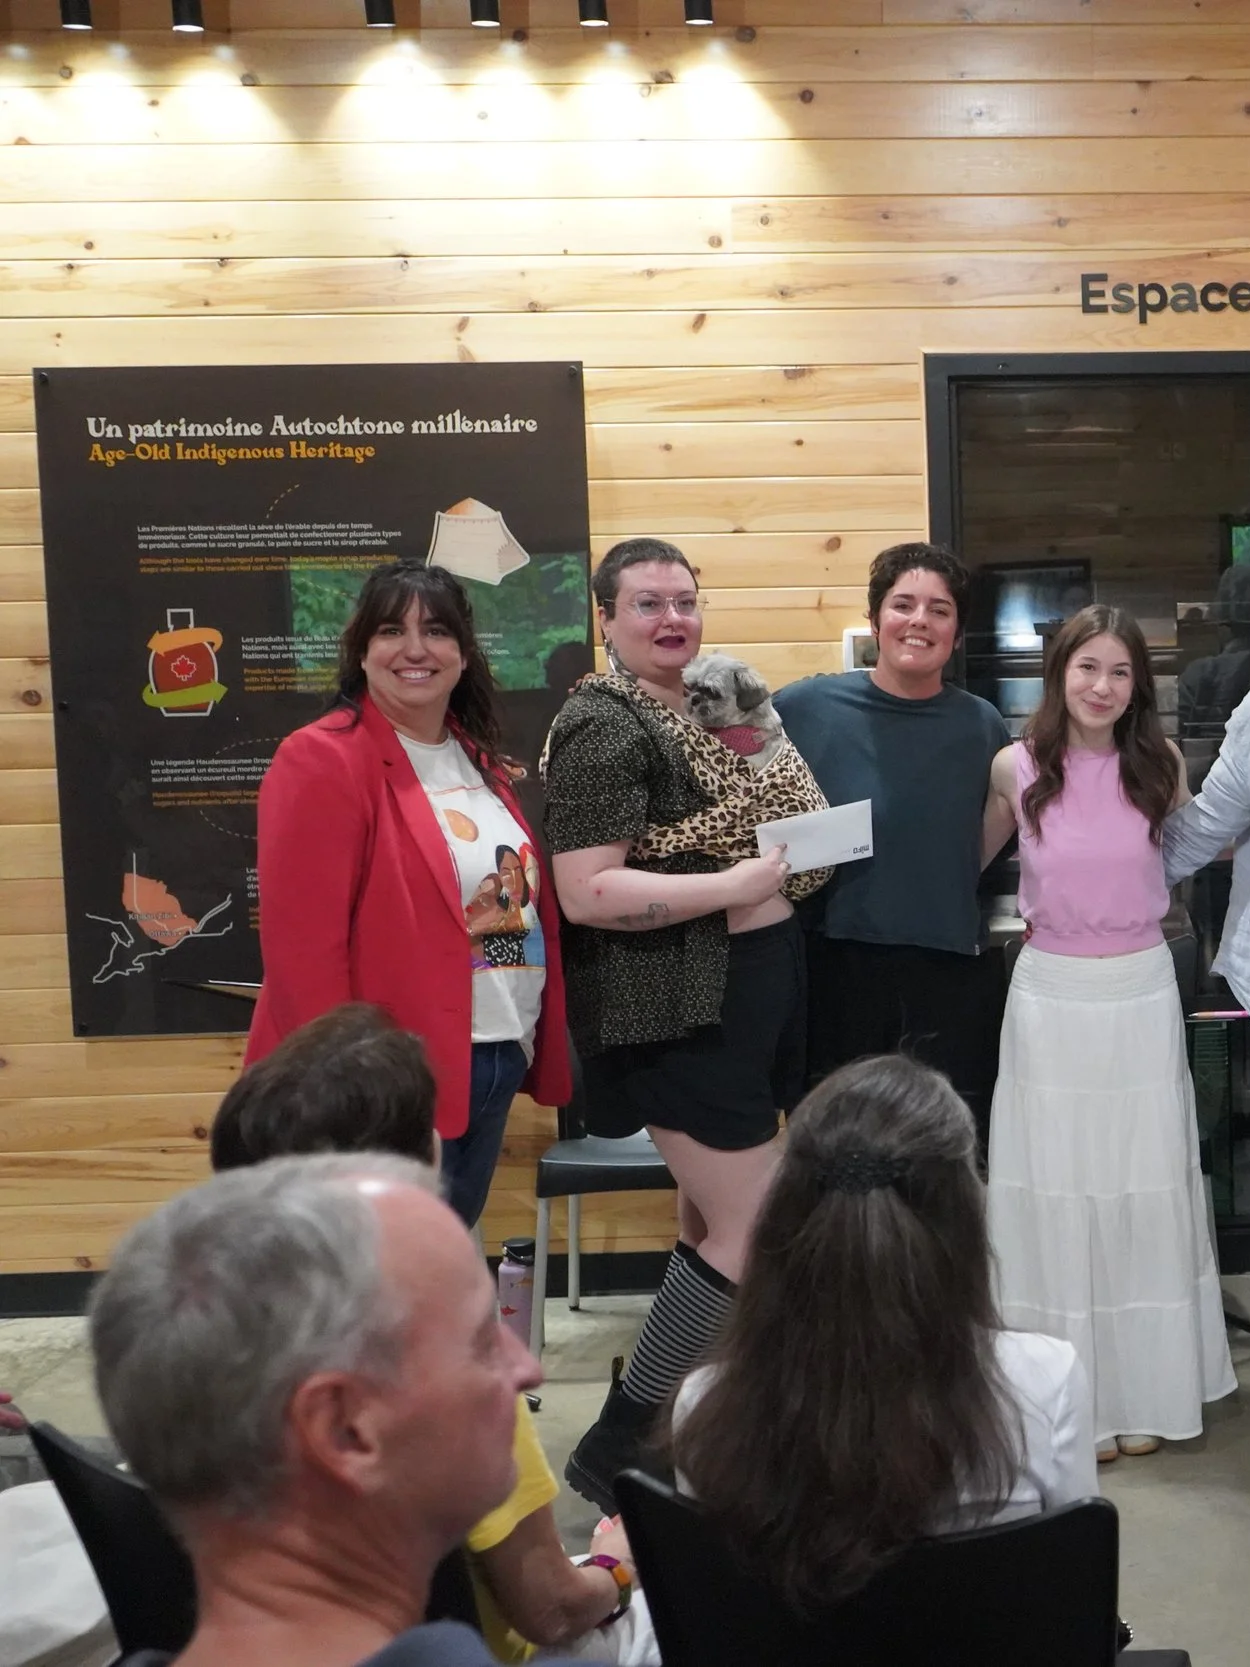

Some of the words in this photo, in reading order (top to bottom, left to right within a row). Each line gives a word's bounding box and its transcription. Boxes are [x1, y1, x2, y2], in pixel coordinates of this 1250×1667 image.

[86, 416, 123, 438] Un
[127, 416, 263, 445] patrimoine
[269, 413, 405, 436] Autochtone
[411, 408, 538, 434] millénaire
[88, 442, 171, 468] Age-Old
[176, 441, 285, 465] Indigenous
[289, 440, 376, 464] Heritage
[312, 523, 336, 531] depuis
